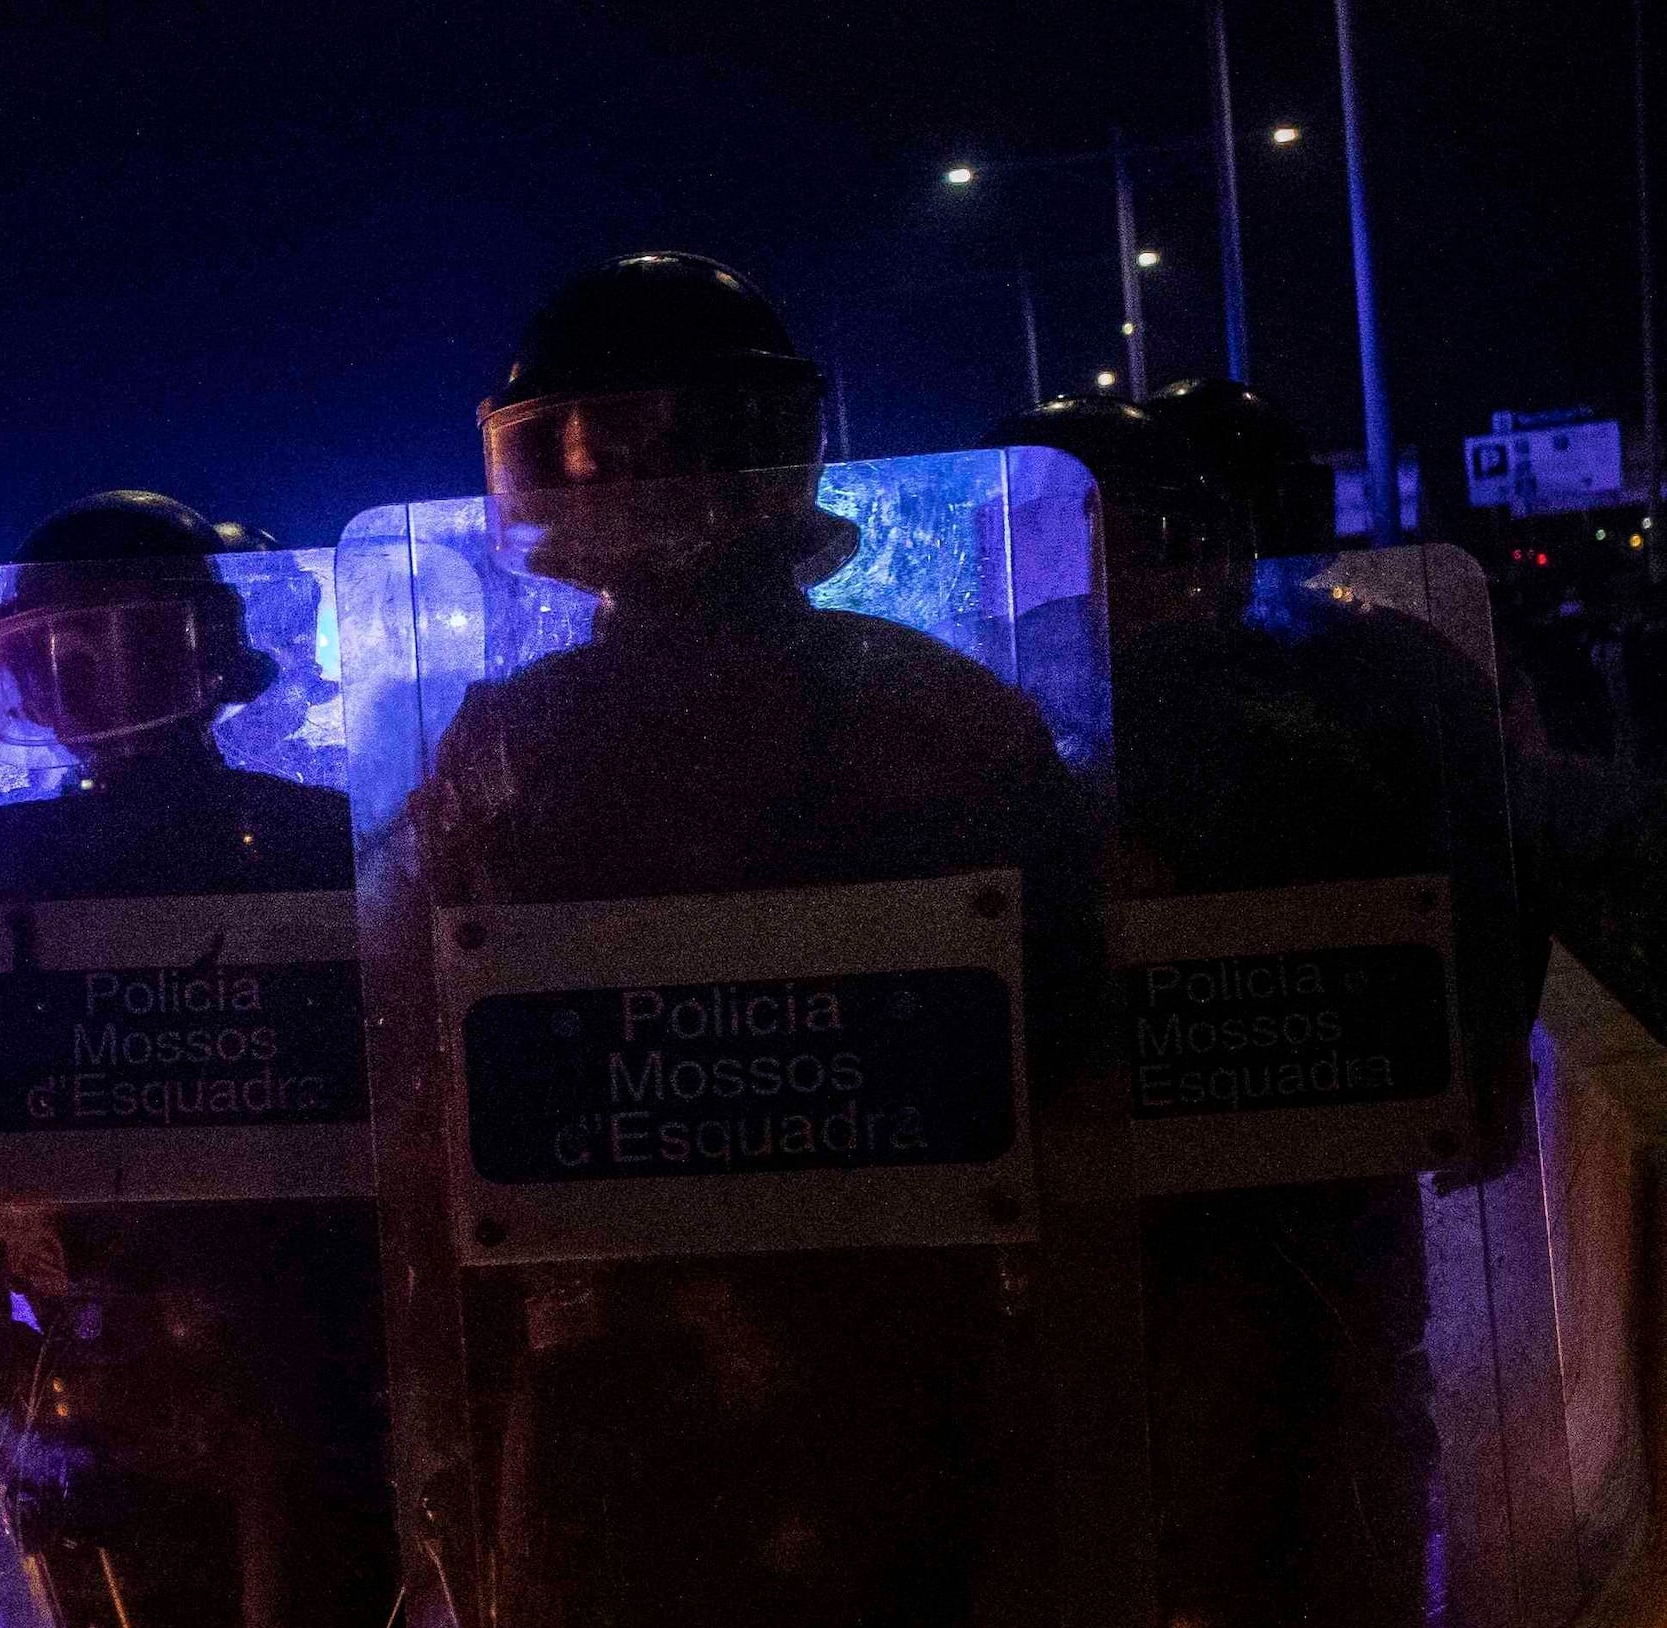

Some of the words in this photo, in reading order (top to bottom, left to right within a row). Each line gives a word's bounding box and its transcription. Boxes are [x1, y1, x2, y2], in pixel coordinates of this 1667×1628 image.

[84, 968, 263, 1018] Policia
[1144, 954, 1327, 1008] Policia
[621, 981, 844, 1042] Policia
[1134, 1009, 1344, 1058] Mossos
[71, 1021, 279, 1067] Mossos
[26, 1065, 329, 1124] d'Esquadra
[607, 1050, 866, 1102] Mossos
[553, 1099, 930, 1171] d'Esquadra
